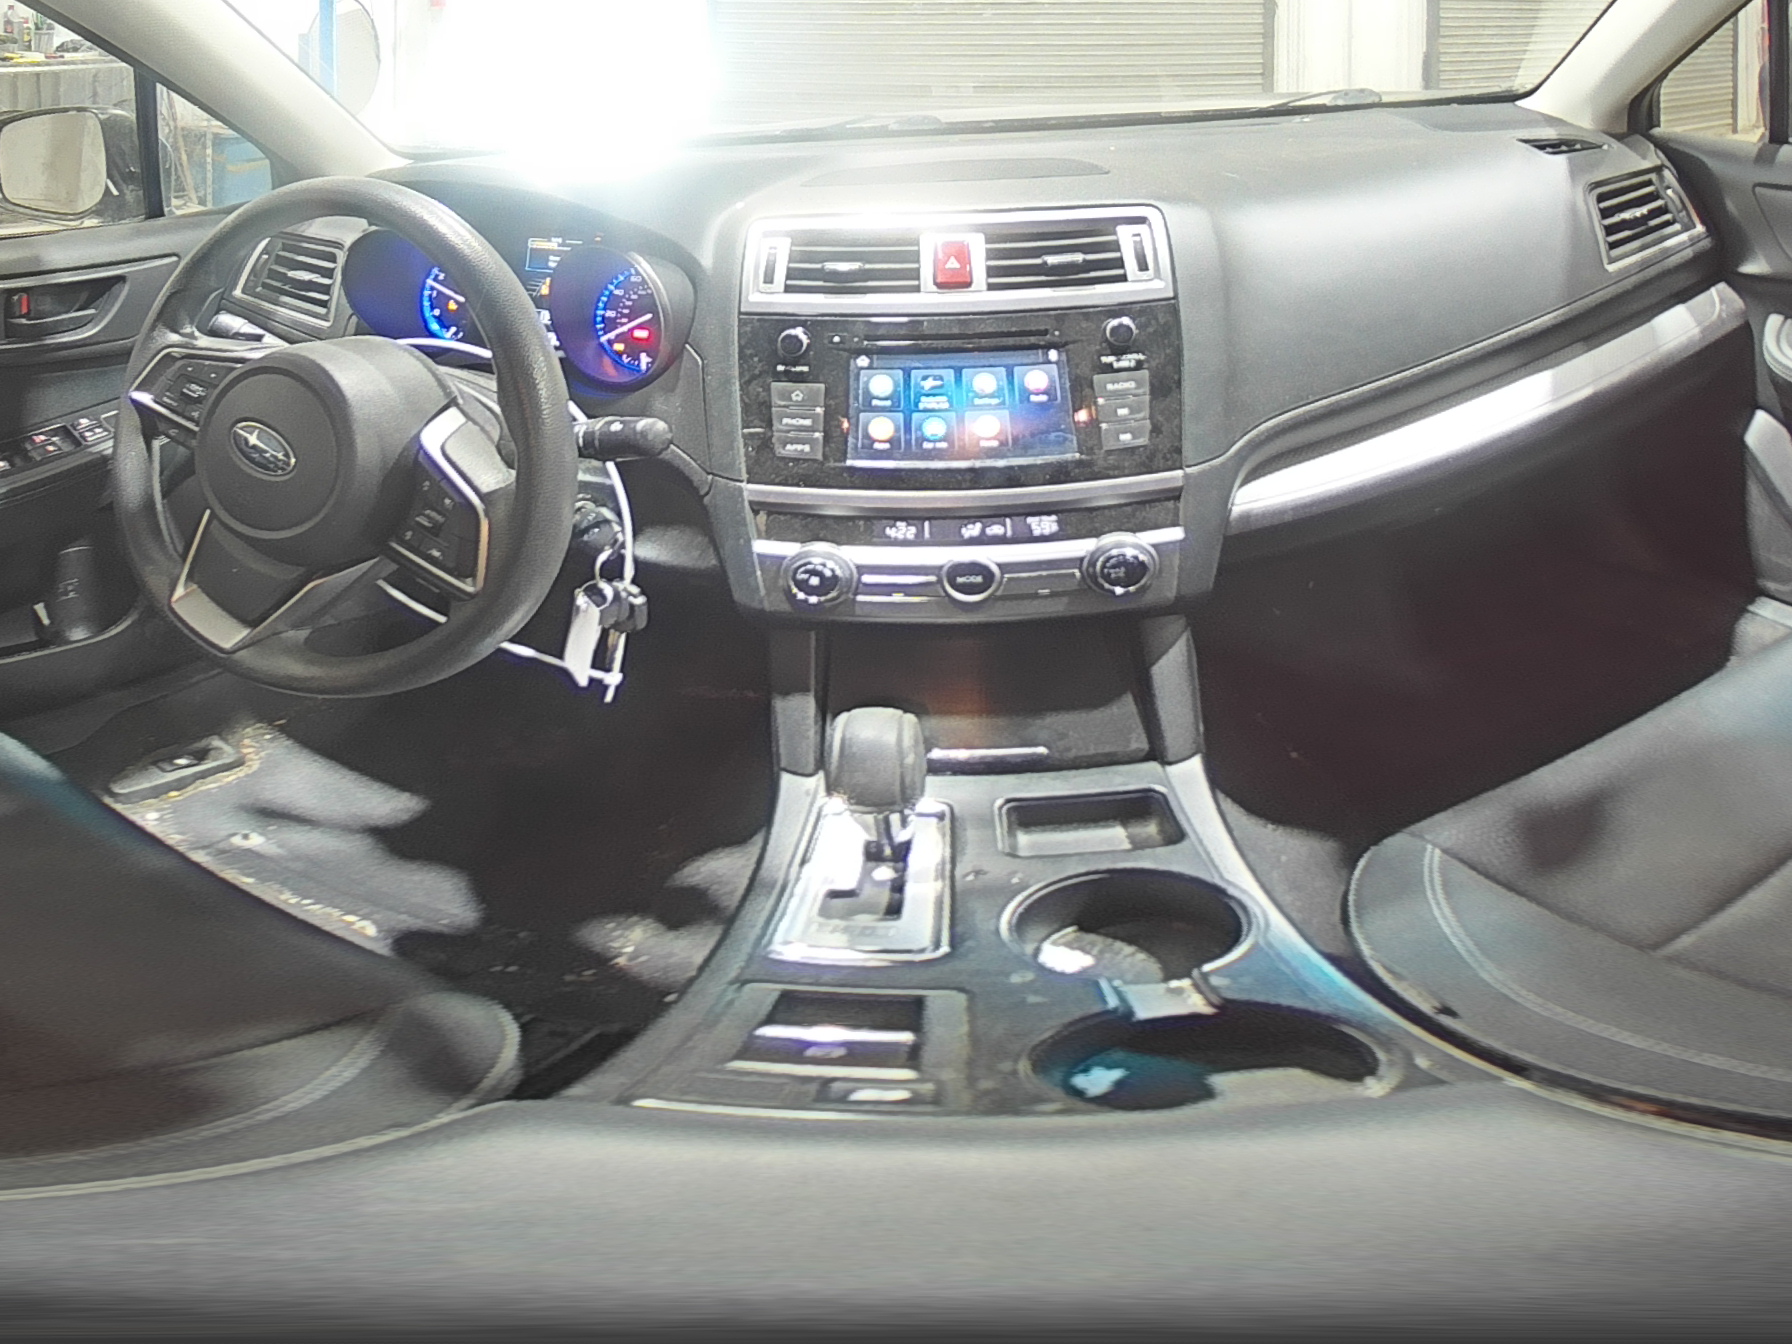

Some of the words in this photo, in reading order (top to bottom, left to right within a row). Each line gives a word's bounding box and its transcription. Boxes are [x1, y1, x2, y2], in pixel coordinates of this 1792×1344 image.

[1106, 381, 1136, 390] RADIO
[782, 418, 812, 426] PHONE
[785, 443, 811, 452] APPS
[956, 575, 983, 583] MODE
